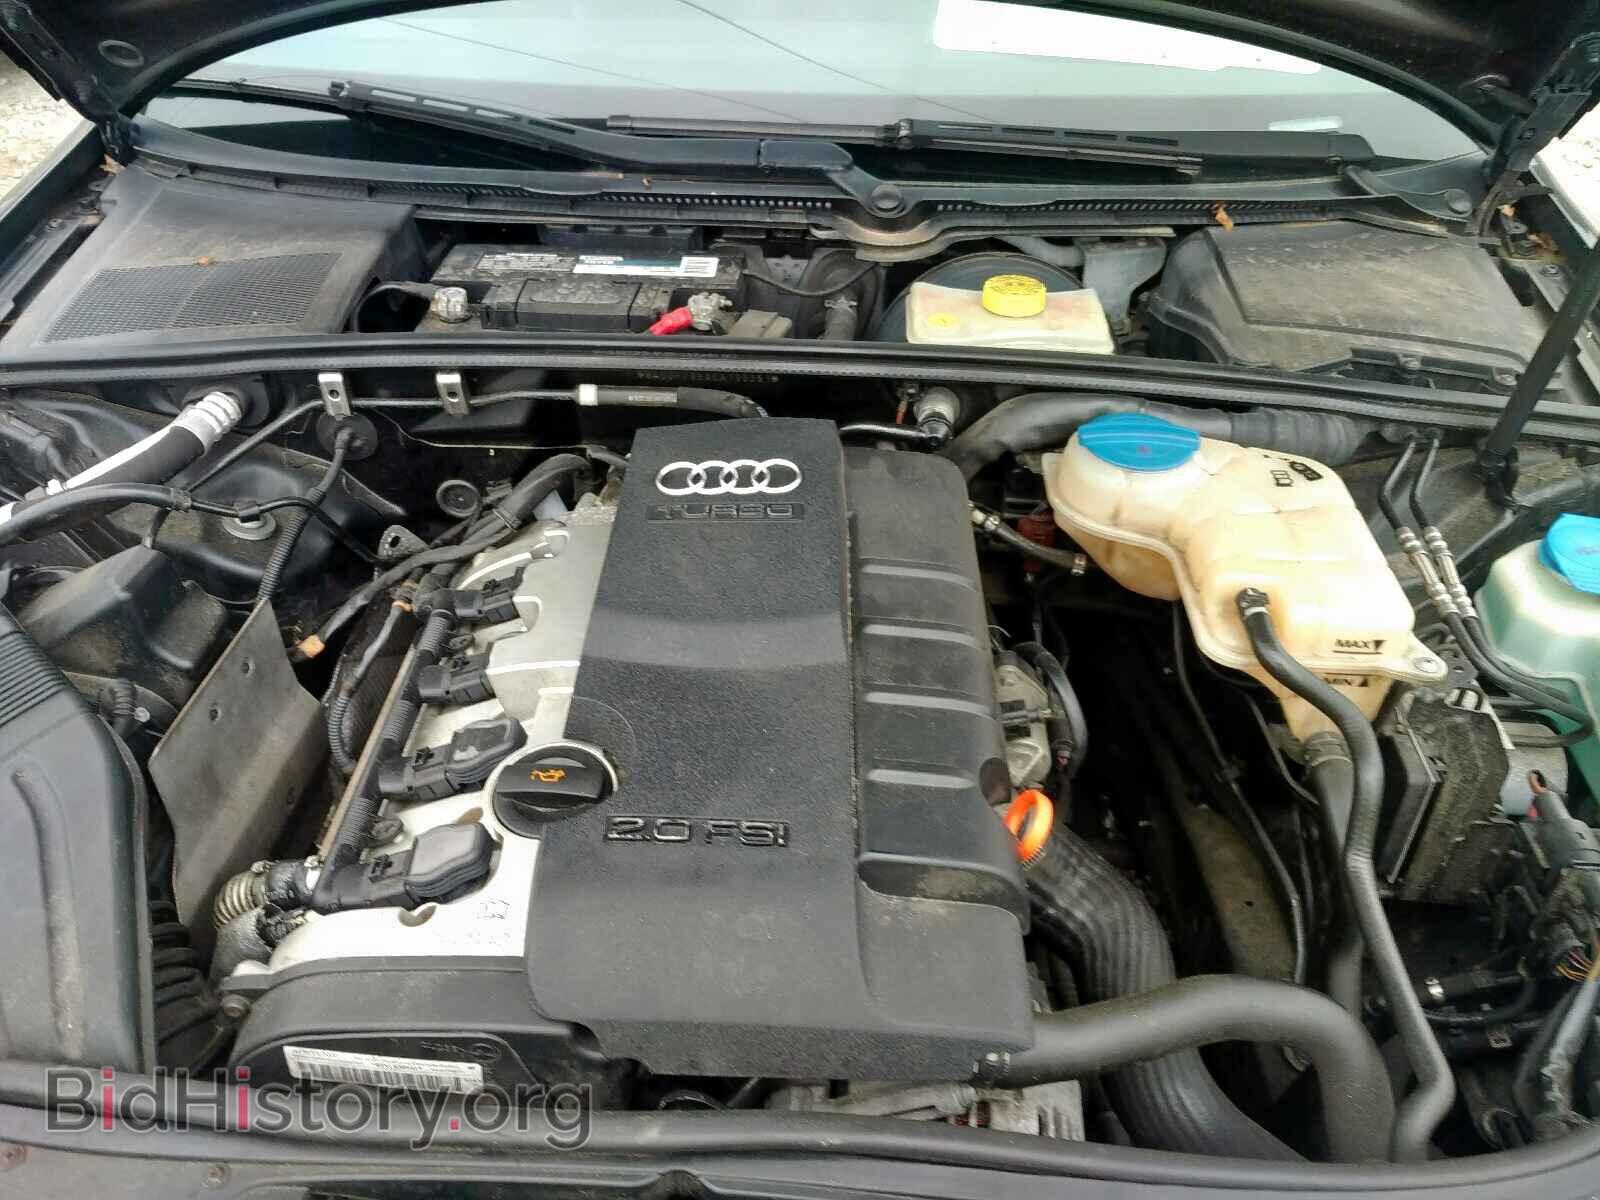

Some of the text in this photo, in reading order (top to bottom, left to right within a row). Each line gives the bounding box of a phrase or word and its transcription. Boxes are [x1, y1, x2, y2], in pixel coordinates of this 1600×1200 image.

[656, 502, 794, 520] TURBO
[1334, 639, 1370, 649] MAX
[703, 819, 790, 847] FSI
